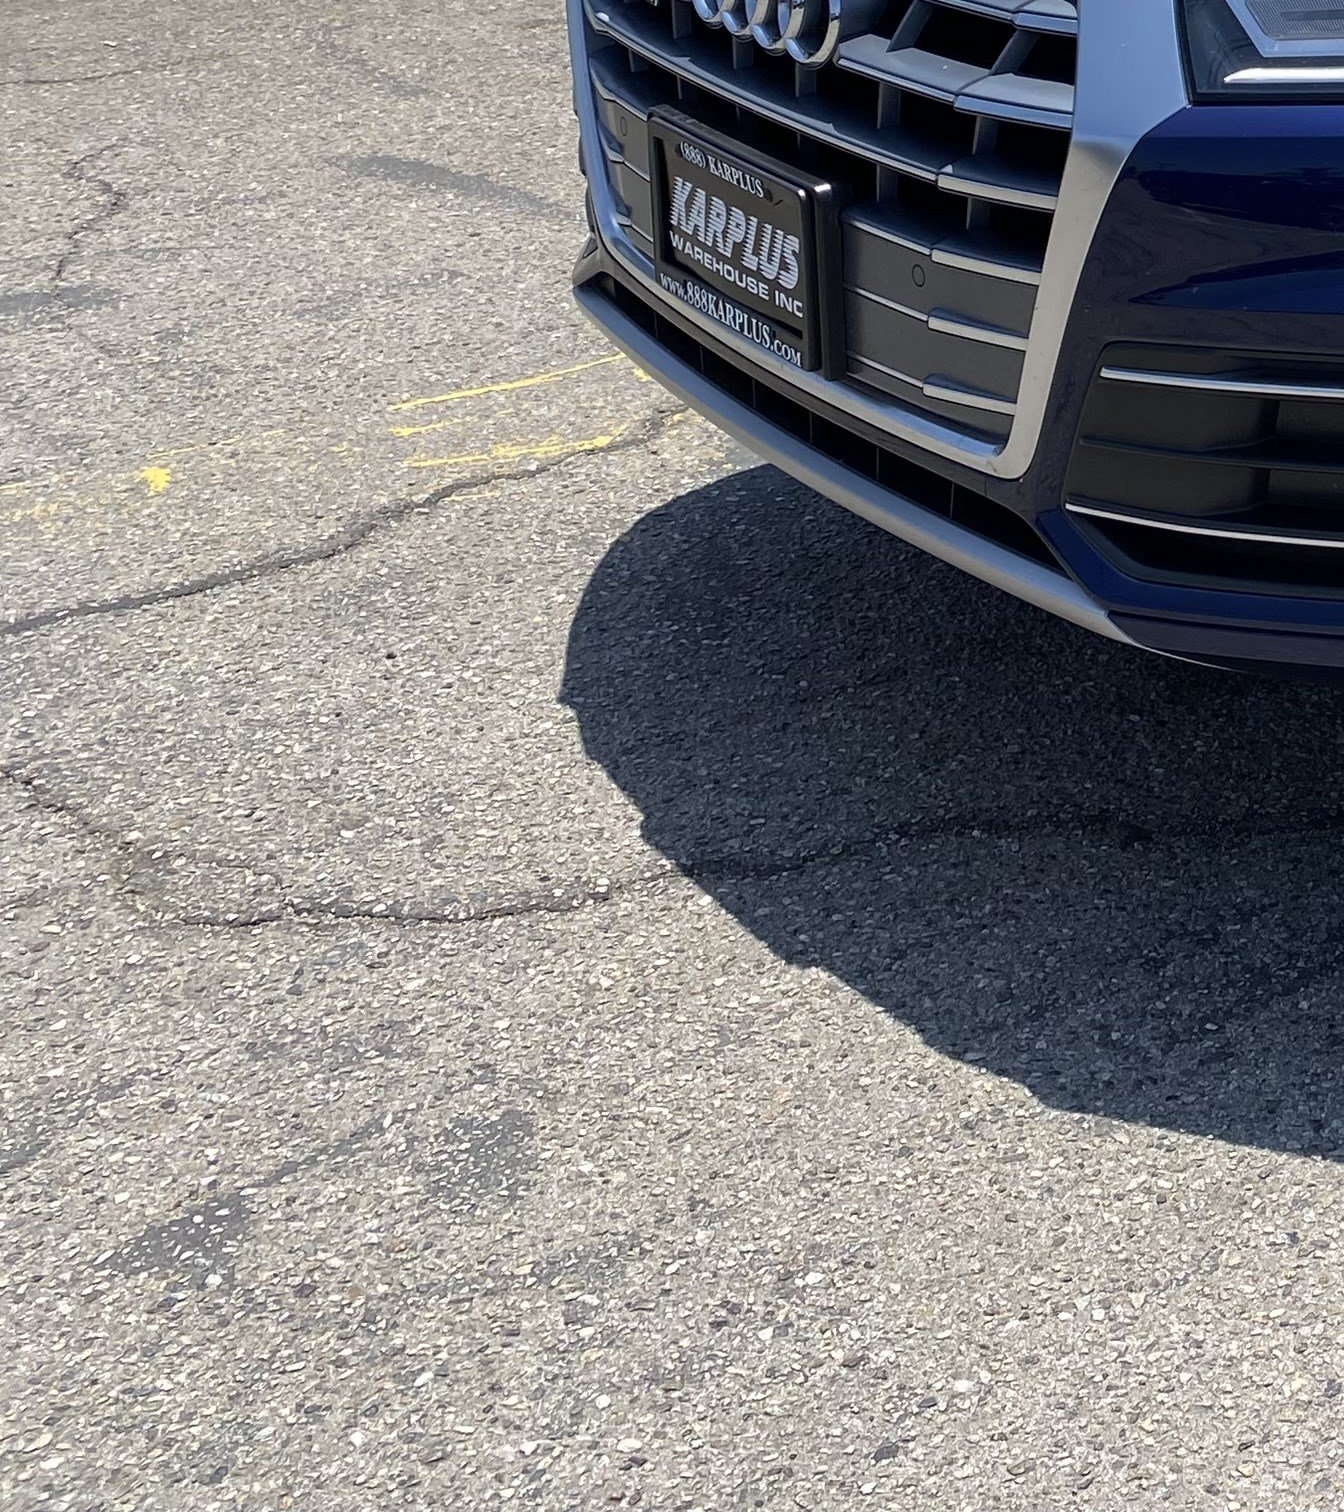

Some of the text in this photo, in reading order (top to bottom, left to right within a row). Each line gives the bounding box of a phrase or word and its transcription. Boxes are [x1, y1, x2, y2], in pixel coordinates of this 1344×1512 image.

[681, 141, 764, 198] (888) KARPLUS
[669, 230, 804, 317] WAREHOUSE INC
[670, 176, 800, 290] KARPLUS
